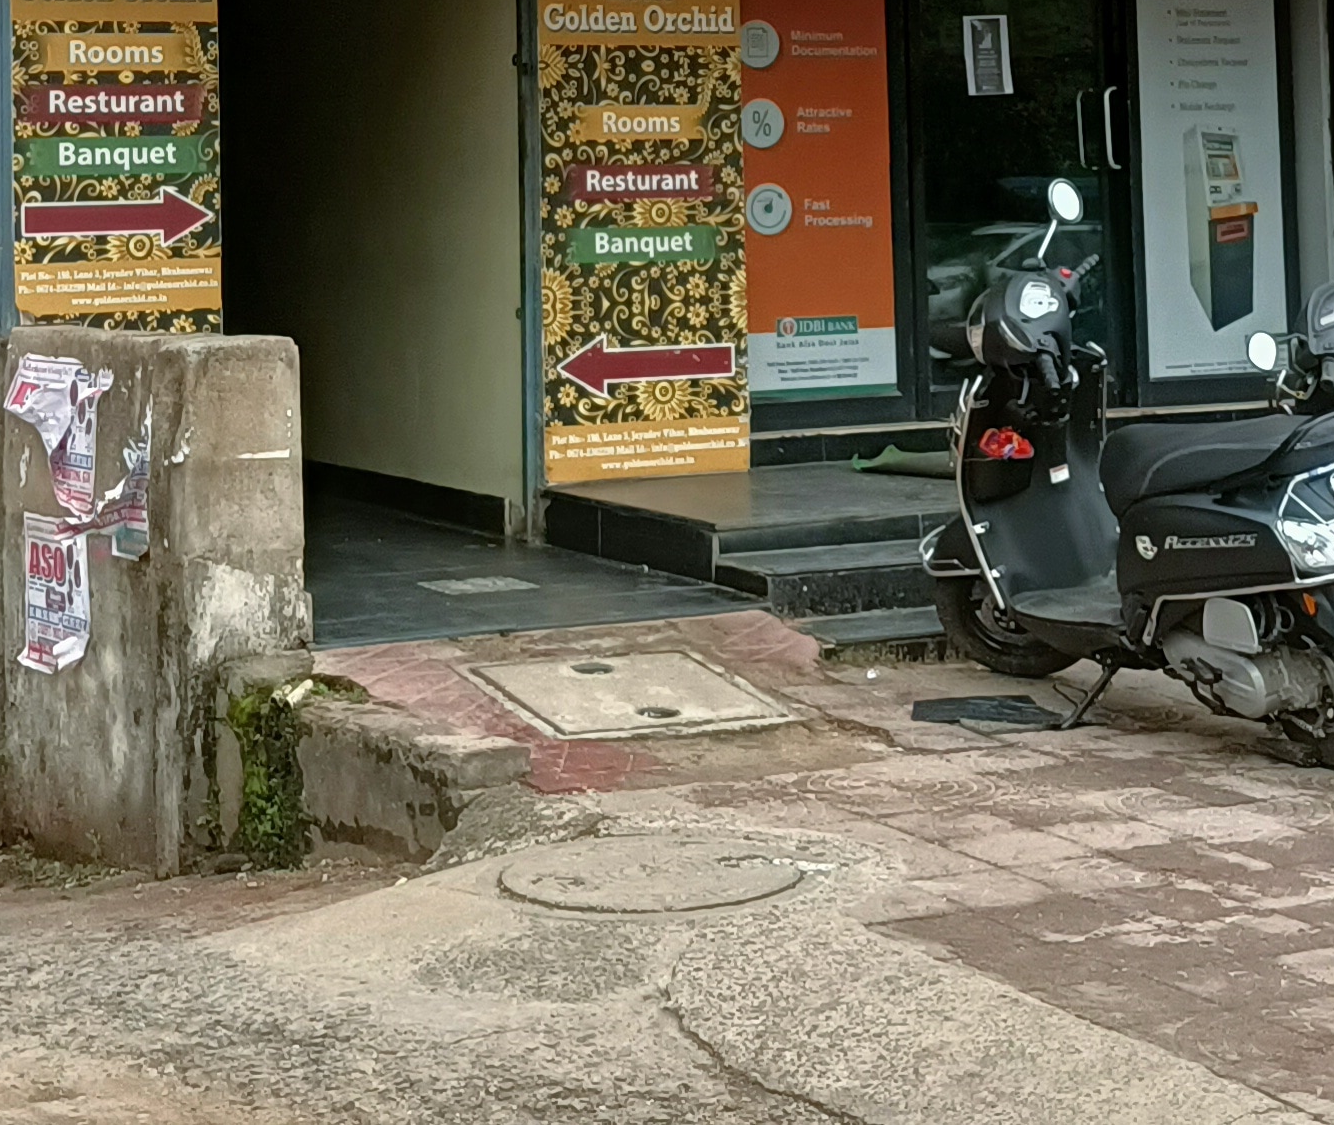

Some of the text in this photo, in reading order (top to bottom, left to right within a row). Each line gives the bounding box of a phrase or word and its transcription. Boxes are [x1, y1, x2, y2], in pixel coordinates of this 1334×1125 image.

[543, 3, 735, 33] Golden Orchid
[790, 30, 843, 42] Minimum
[69, 40, 164, 64] Rooms
[791, 44, 878, 57] Documentation
[48, 90, 185, 114] Resturant
[796, 106, 853, 119] Attractive
[602, 112, 681, 133] Rooms
[797, 122, 830, 134] Rates
[58, 142, 177, 171] Banquet
[586, 170, 699, 192] Resturant
[804, 198, 830, 211] Fast
[804, 214, 873, 228] Processing
[595, 232, 693, 258] Banquet
[798, 320, 826, 334] IDBI
